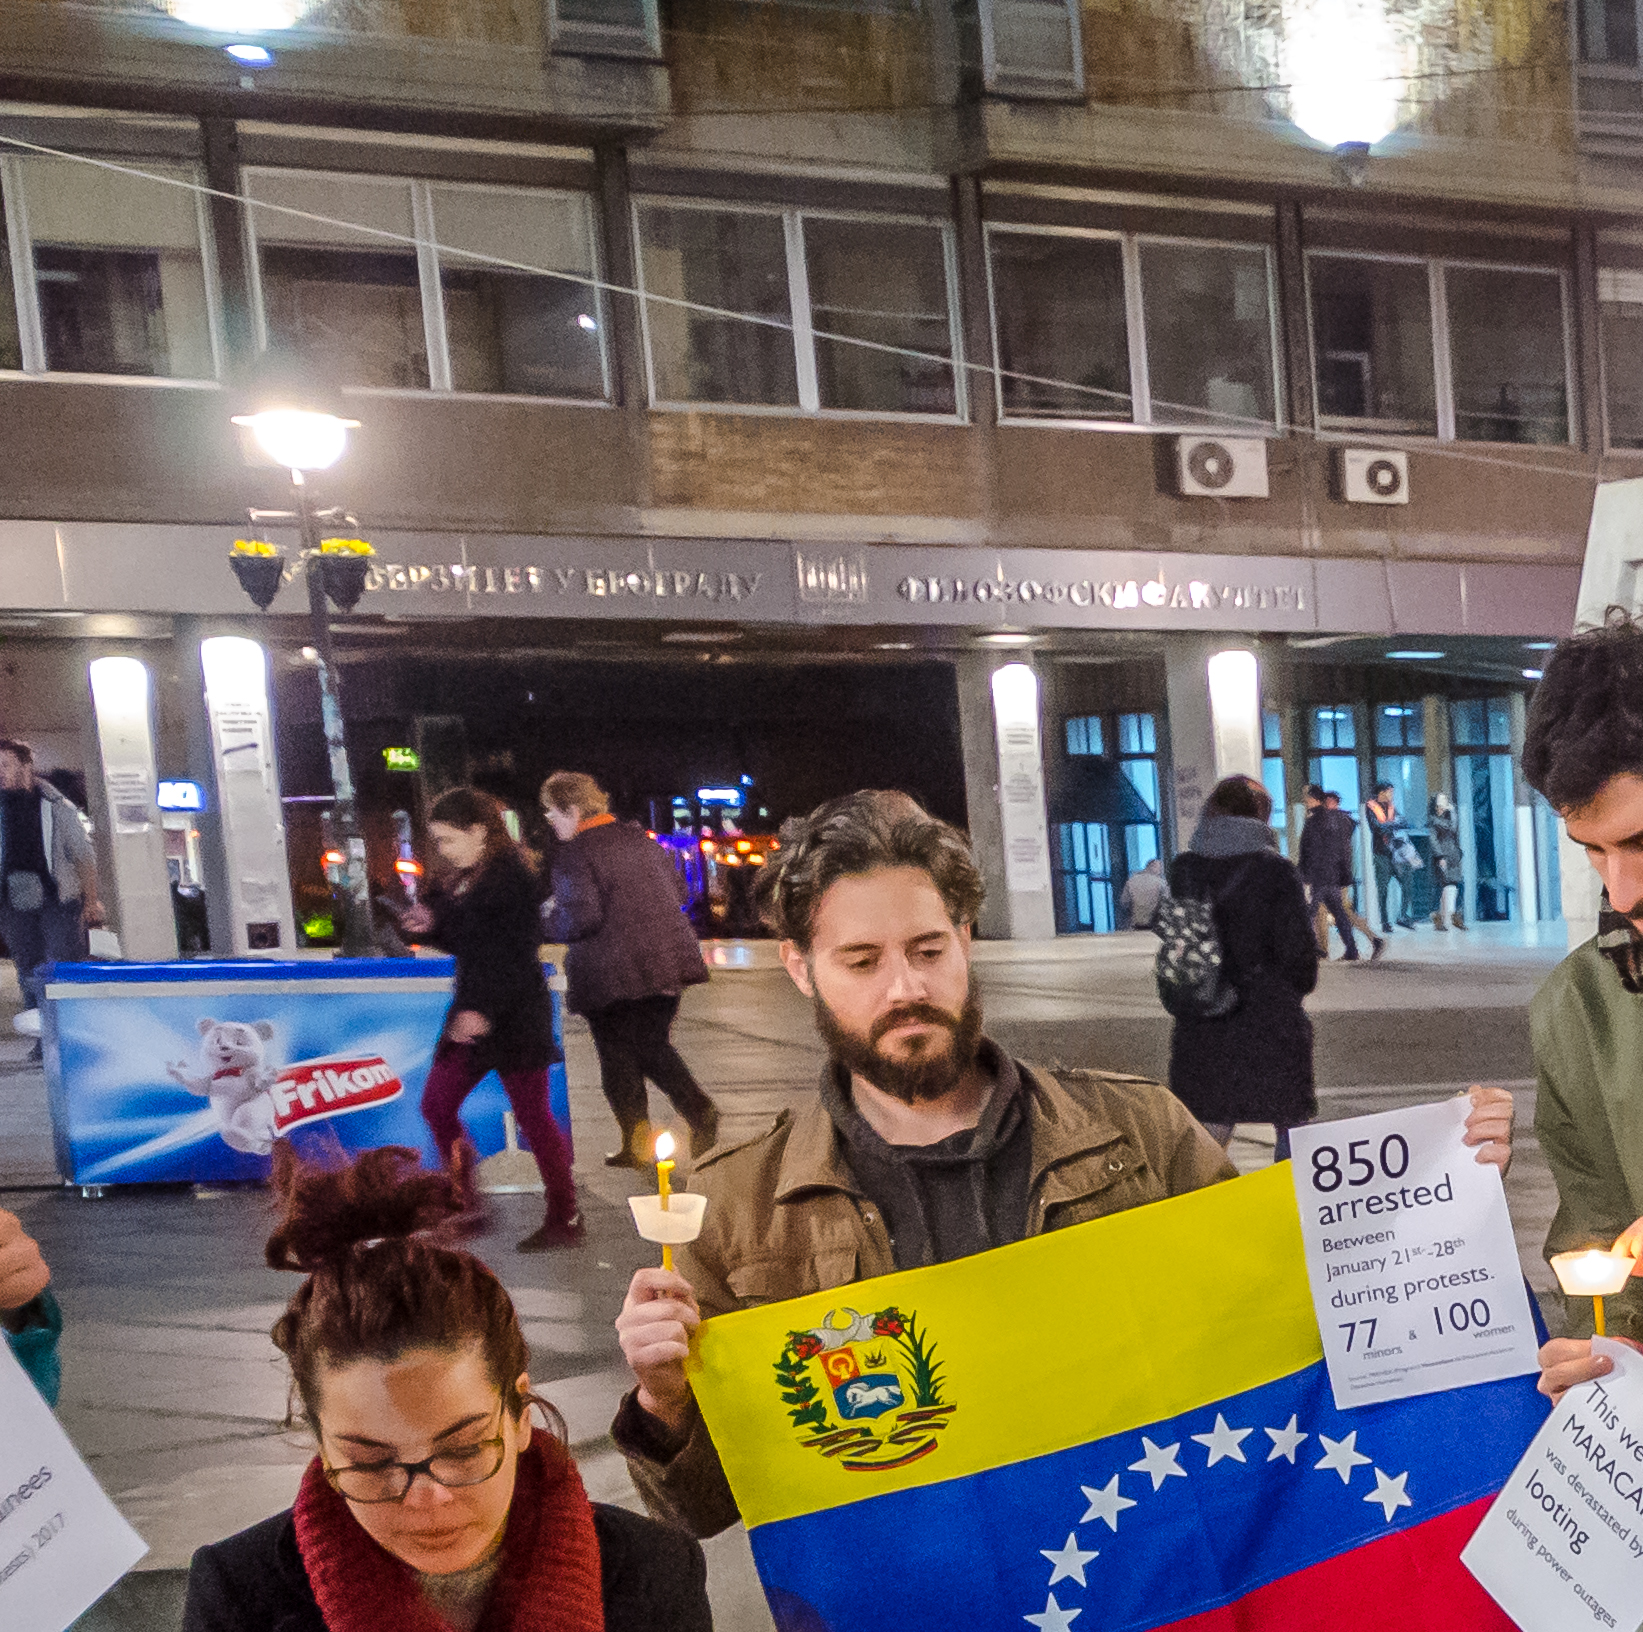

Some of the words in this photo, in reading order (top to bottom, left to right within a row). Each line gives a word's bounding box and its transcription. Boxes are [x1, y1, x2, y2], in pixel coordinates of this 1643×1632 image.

[1311, 1133, 1411, 1193] 850
[1318, 1172, 1454, 1226] arrested
[1322, 1228, 1396, 1254] Between
[1326, 1254, 1388, 1282] January
[1330, 1284, 1400, 1309] during
[1403, 1265, 1496, 1302] protests.
[1338, 1317, 1378, 1354] 77
[1433, 1298, 1491, 1336] 100
[1362, 1345, 1404, 1361] minors
[1585, 1380, 1620, 1431] This
[1524, 1468, 1591, 1556] looting
[1545, 1446, 1568, 1477] was
[1566, 1472, 1631, 1542] devastated
[1506, 1506, 1540, 1550] during
[1535, 1542, 1575, 1584] power
[1572, 1582, 1619, 1630] outages
